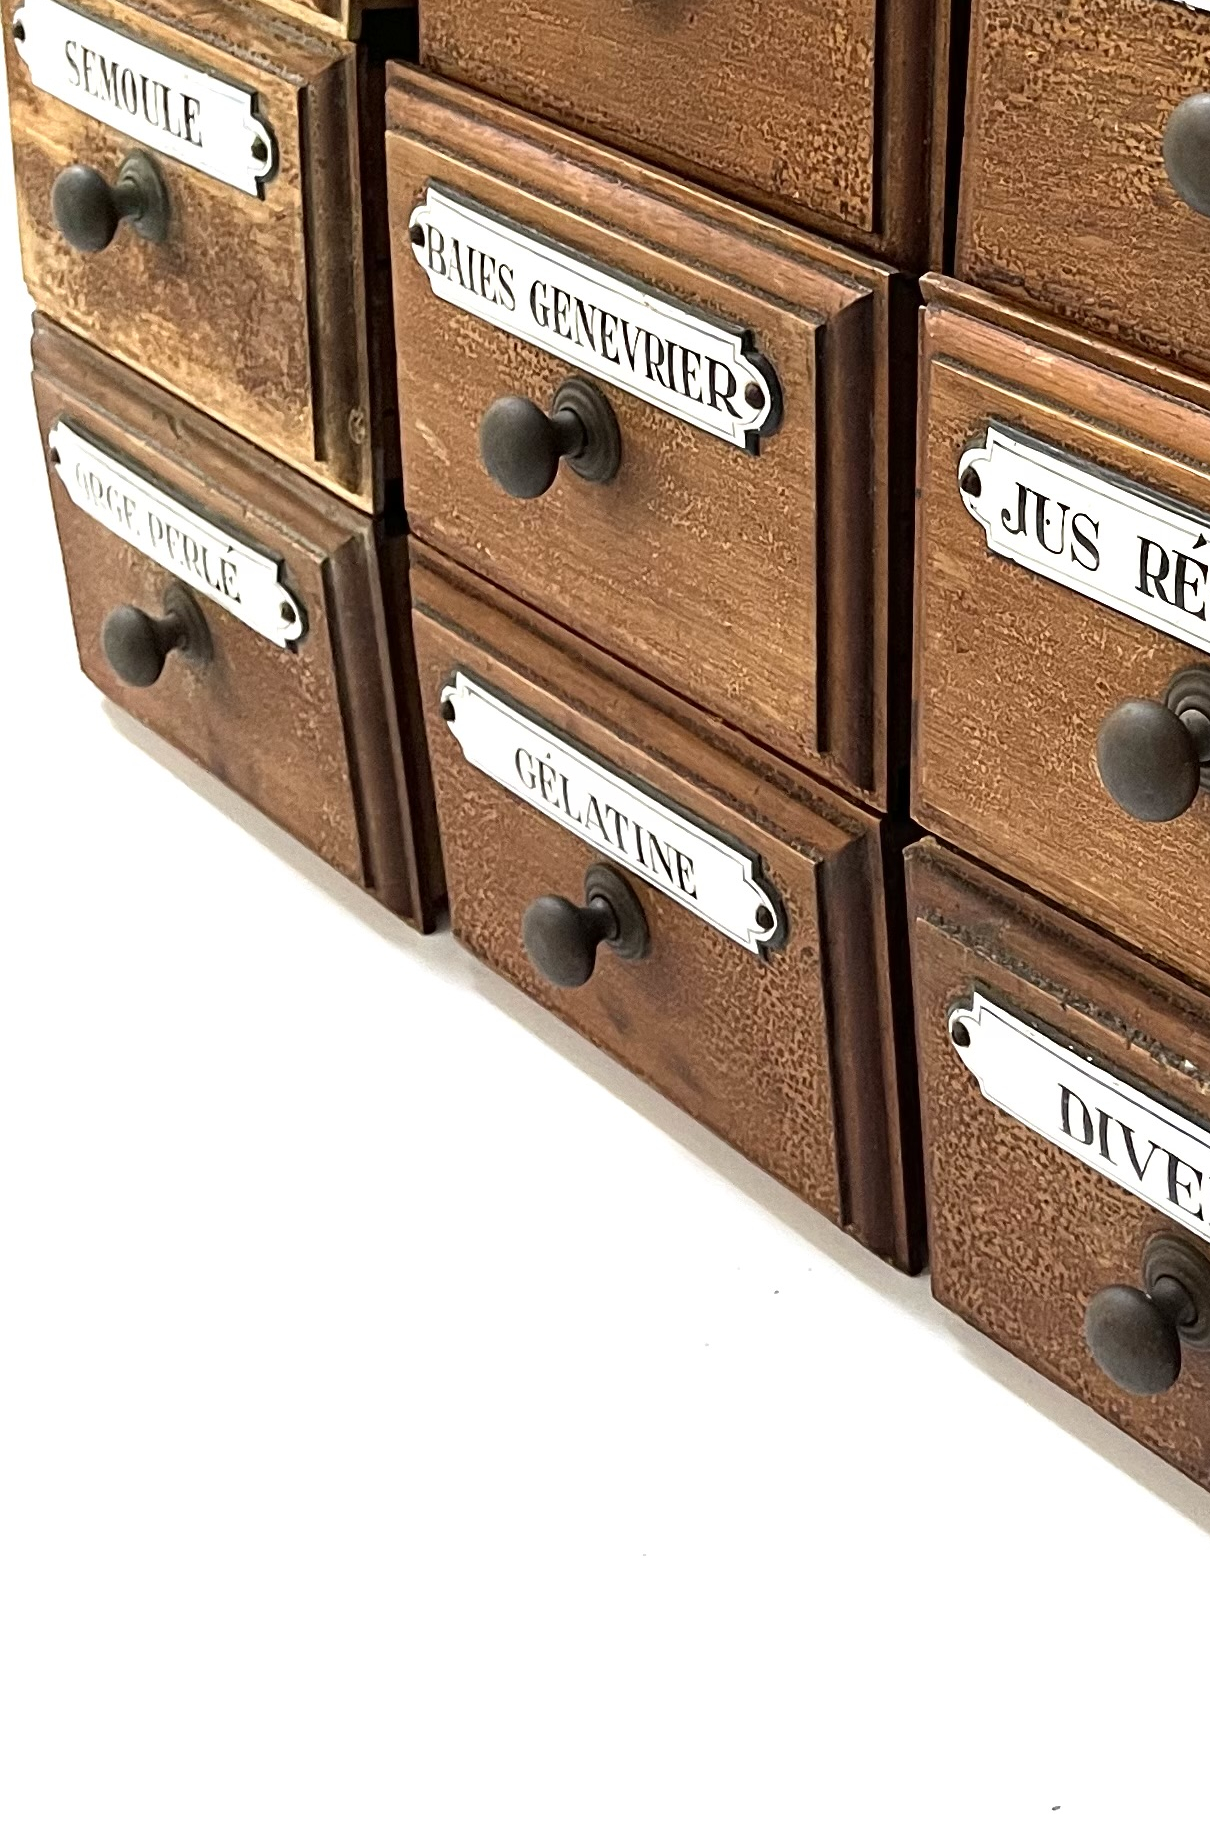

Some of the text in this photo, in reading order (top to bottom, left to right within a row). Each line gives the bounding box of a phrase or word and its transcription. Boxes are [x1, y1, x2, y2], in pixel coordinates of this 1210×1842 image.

[64, 39, 204, 148] SEMOULE
[424, 222, 744, 420] BAIES GENEVRIER
[1000, 481, 1101, 572] JUS
[513, 746, 698, 901] GÉLATINE
